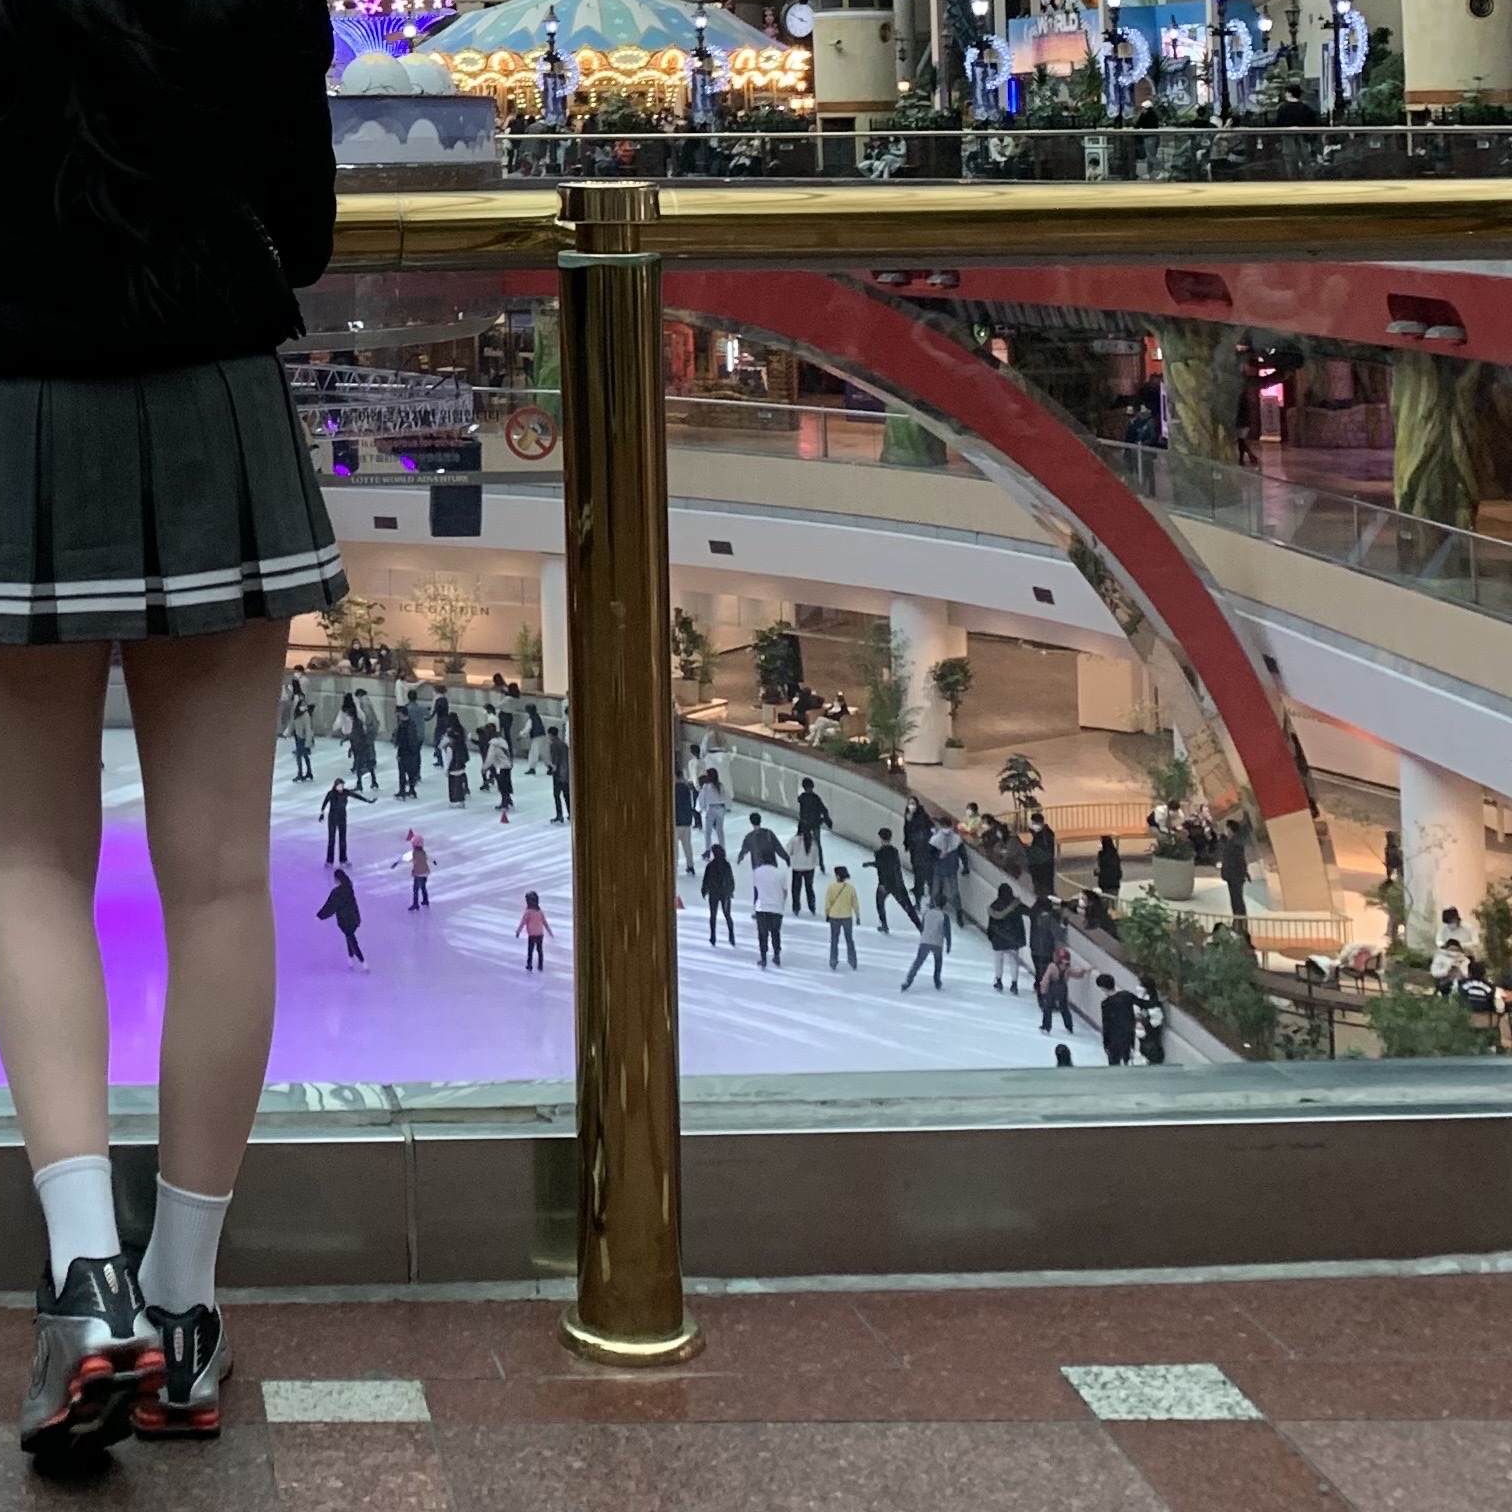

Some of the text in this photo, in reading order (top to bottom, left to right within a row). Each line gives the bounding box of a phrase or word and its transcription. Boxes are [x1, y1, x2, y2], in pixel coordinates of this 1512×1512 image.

[351, 475, 469, 484] LOTTE WORLD ADVENTURE
[399, 603, 425, 614] ICE
